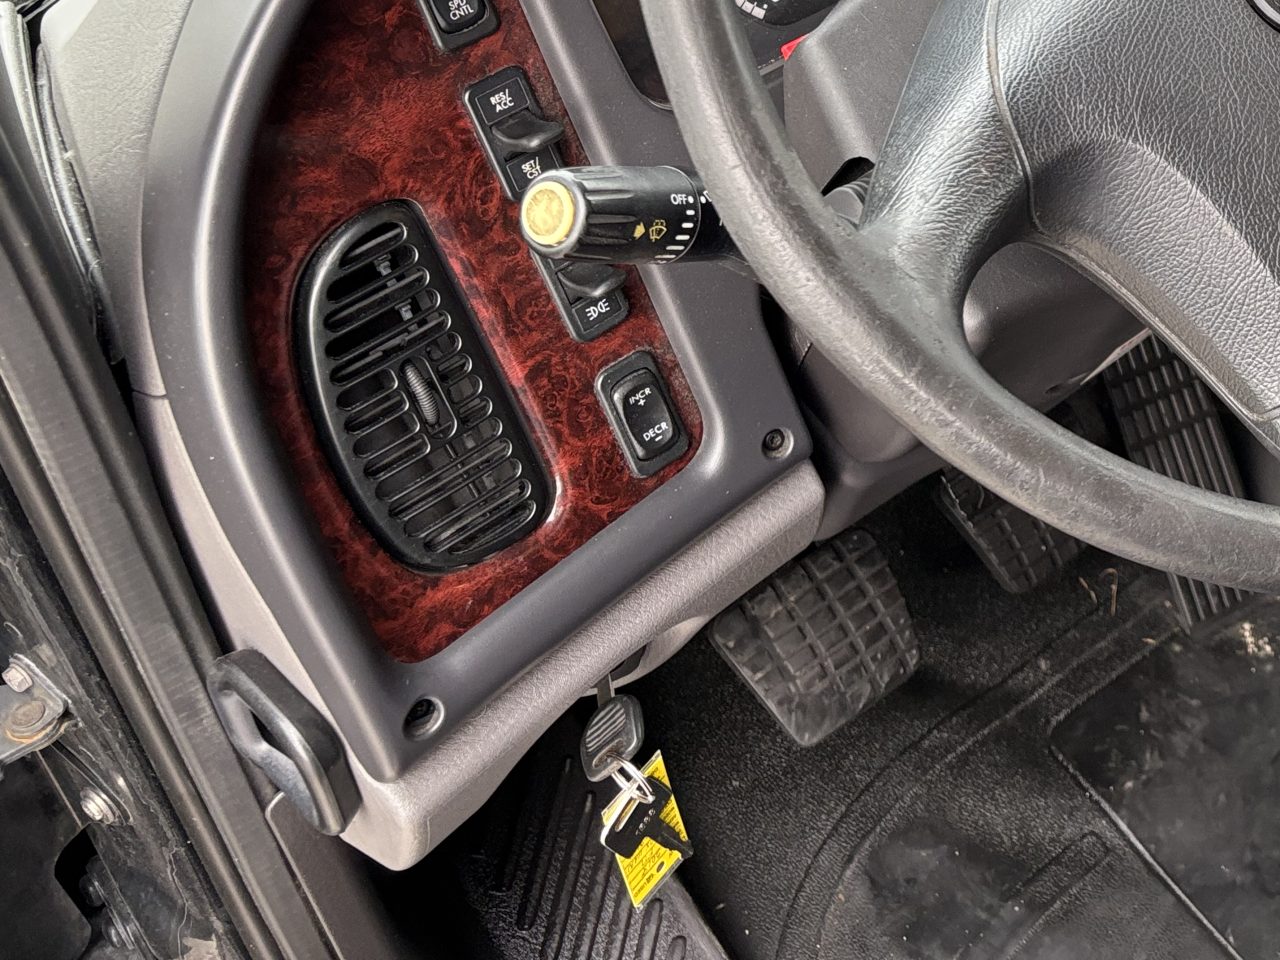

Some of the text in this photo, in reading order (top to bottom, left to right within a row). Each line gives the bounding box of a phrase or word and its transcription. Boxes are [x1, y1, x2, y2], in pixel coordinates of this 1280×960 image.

[450, 4, 474, 20] CNTL
[496, 97, 514, 113] ACC
[526, 165, 542, 179] CST
[670, 193, 687, 205] OFF
[629, 387, 652, 405] INCR
[643, 422, 669, 441] DECR
